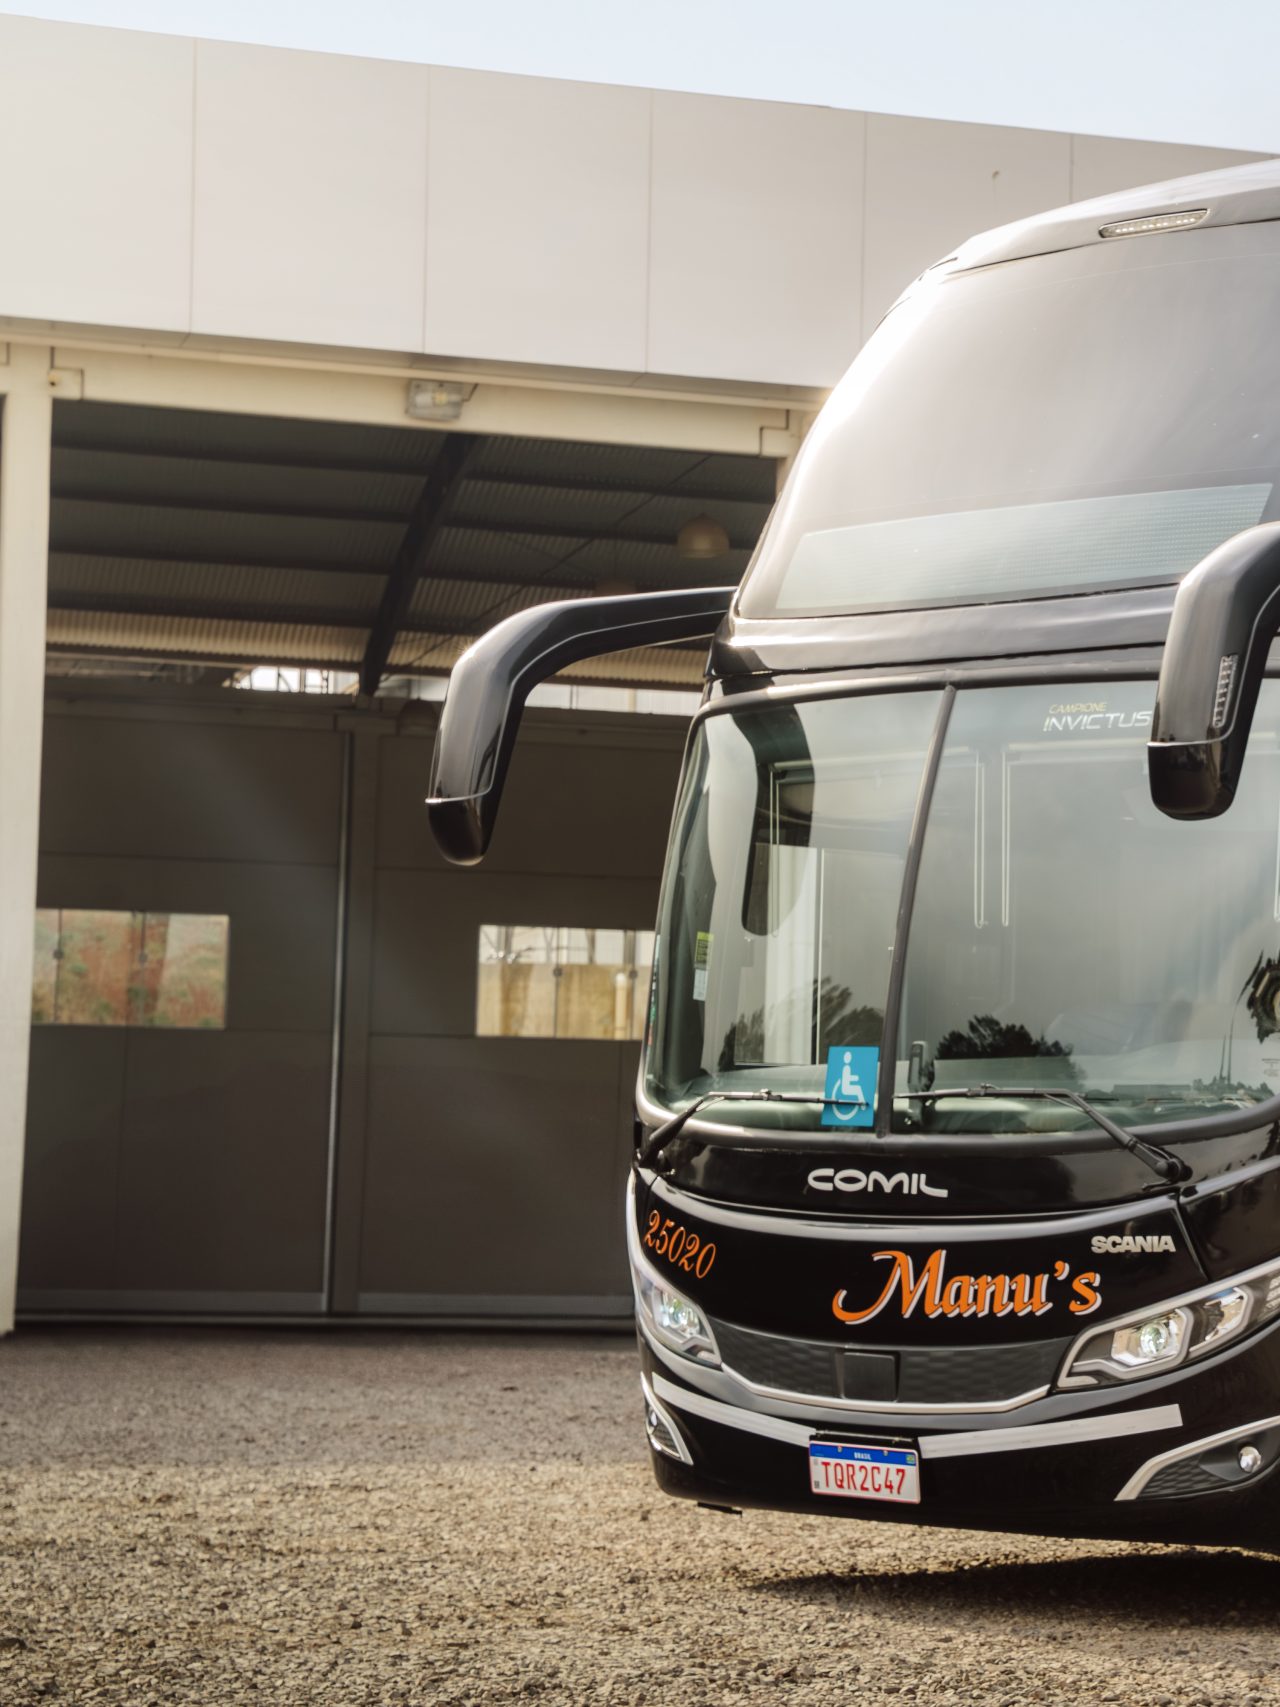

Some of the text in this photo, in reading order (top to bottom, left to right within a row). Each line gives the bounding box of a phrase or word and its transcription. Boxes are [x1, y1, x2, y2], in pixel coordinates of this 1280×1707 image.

[1043, 710, 1153, 732] INVICTUS
[1049, 702, 1107, 714] CAMPIONE
[807, 1168, 949, 1198] COMIL
[644, 1209, 717, 1279] 25020
[1091, 1235, 1176, 1254] SCANIA
[832, 1249, 1102, 1325] Manu's
[853, 1452, 871, 1460] BRASIL
[821, 1461, 906, 1495] TQR2C47
